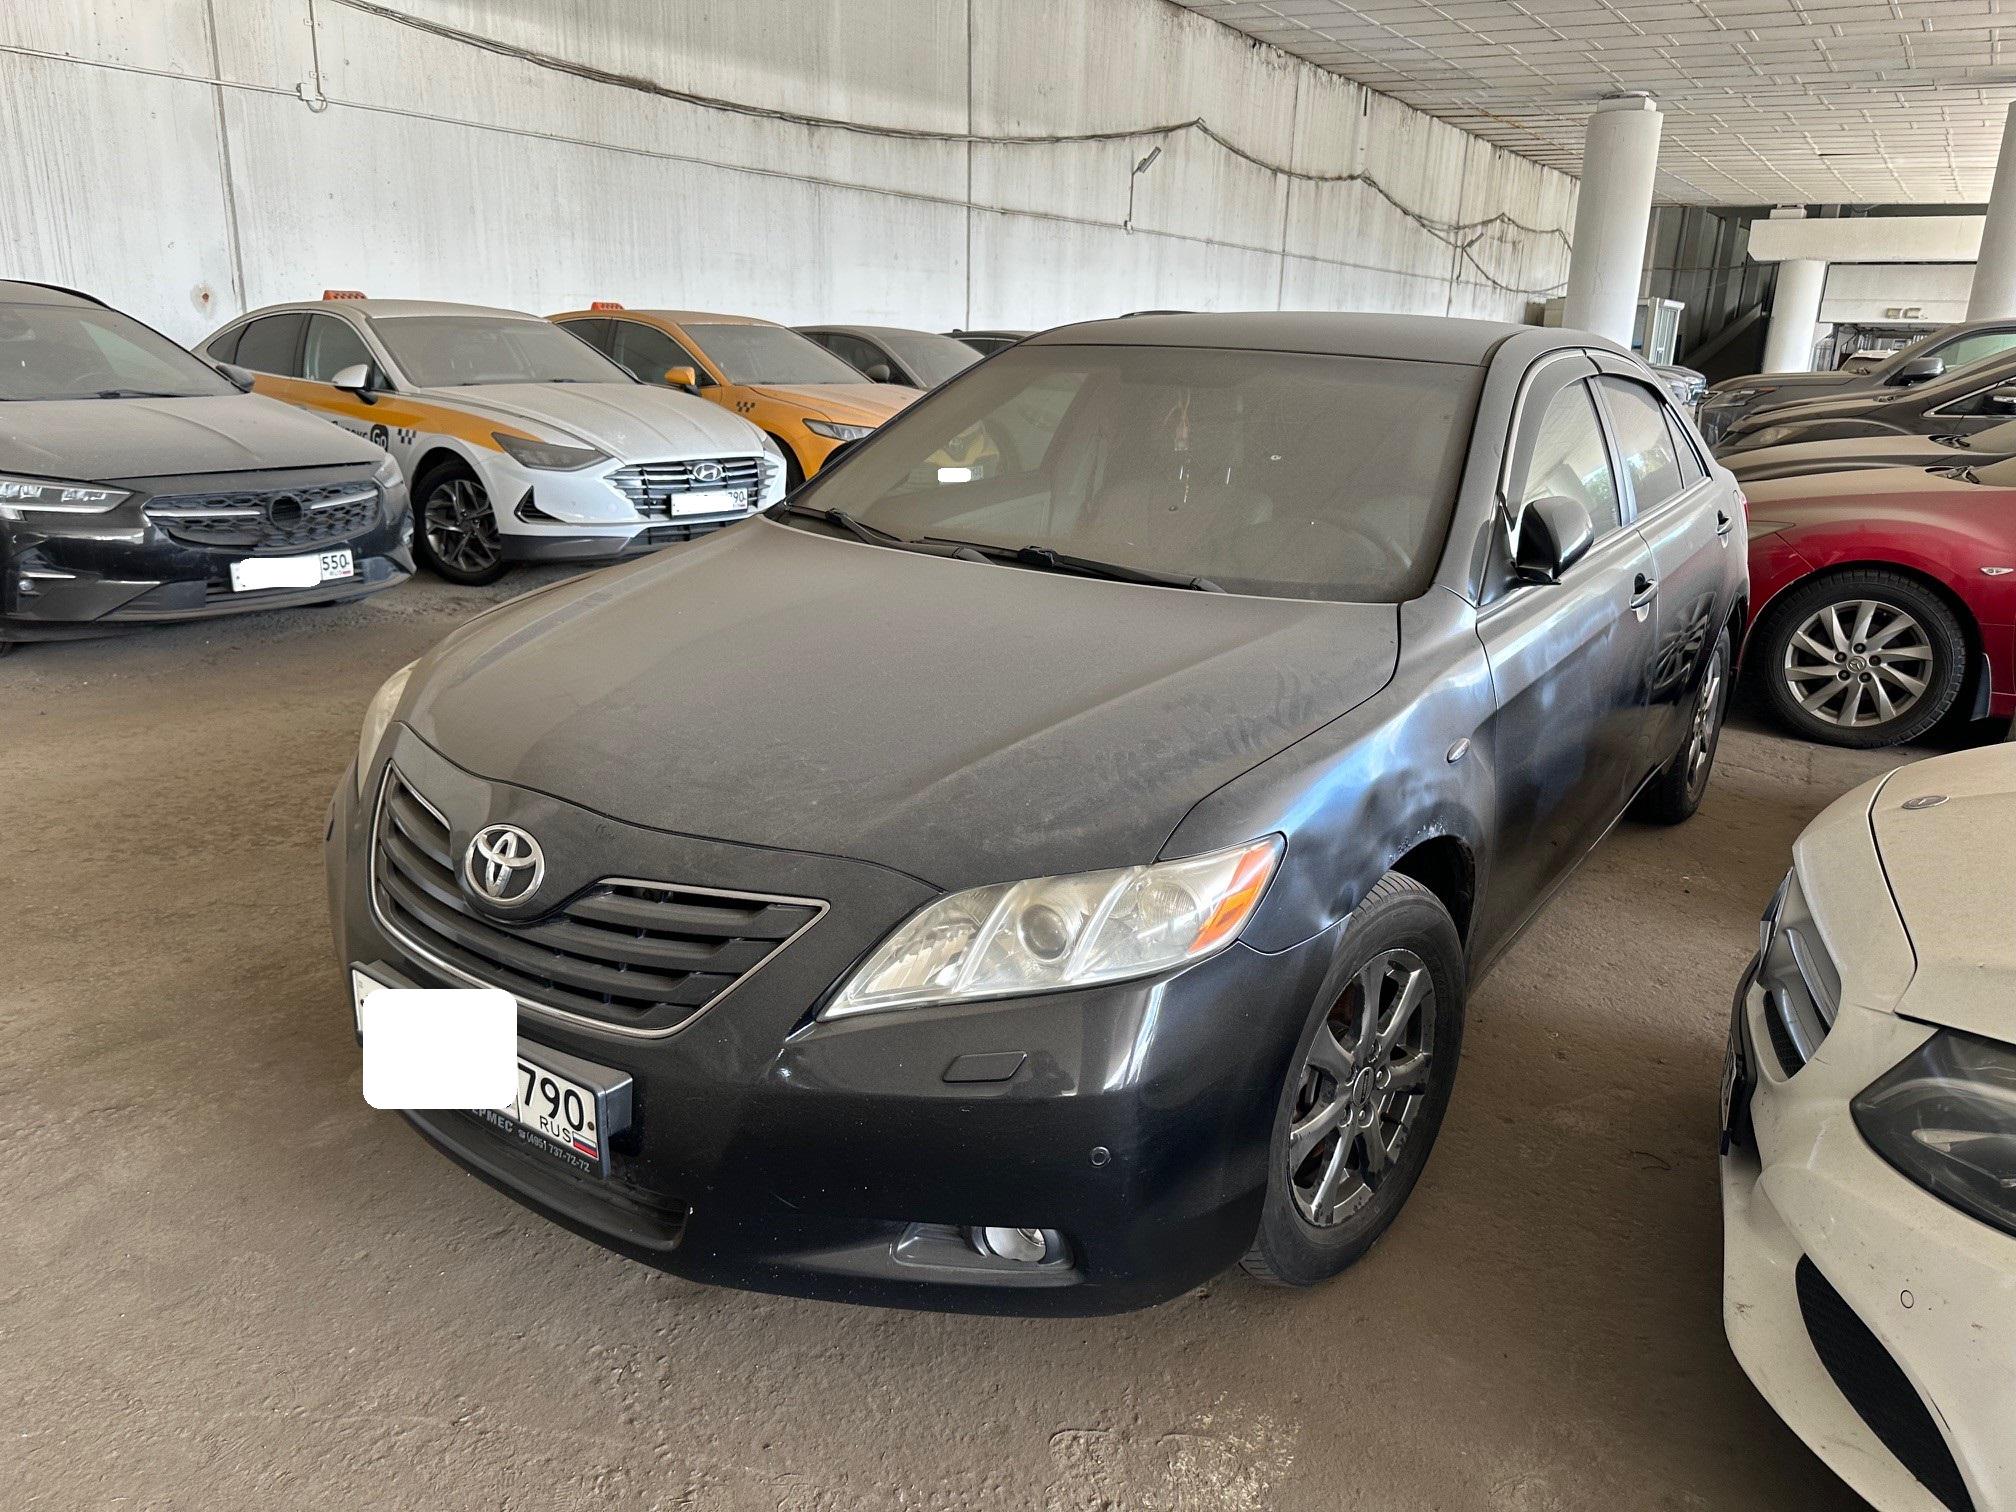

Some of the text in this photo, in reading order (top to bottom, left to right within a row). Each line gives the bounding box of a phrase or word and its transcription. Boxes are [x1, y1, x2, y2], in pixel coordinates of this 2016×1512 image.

[322, 554, 347, 571] 550
[517, 1062, 585, 1132] 790
[539, 1115, 572, 1143] RUS
